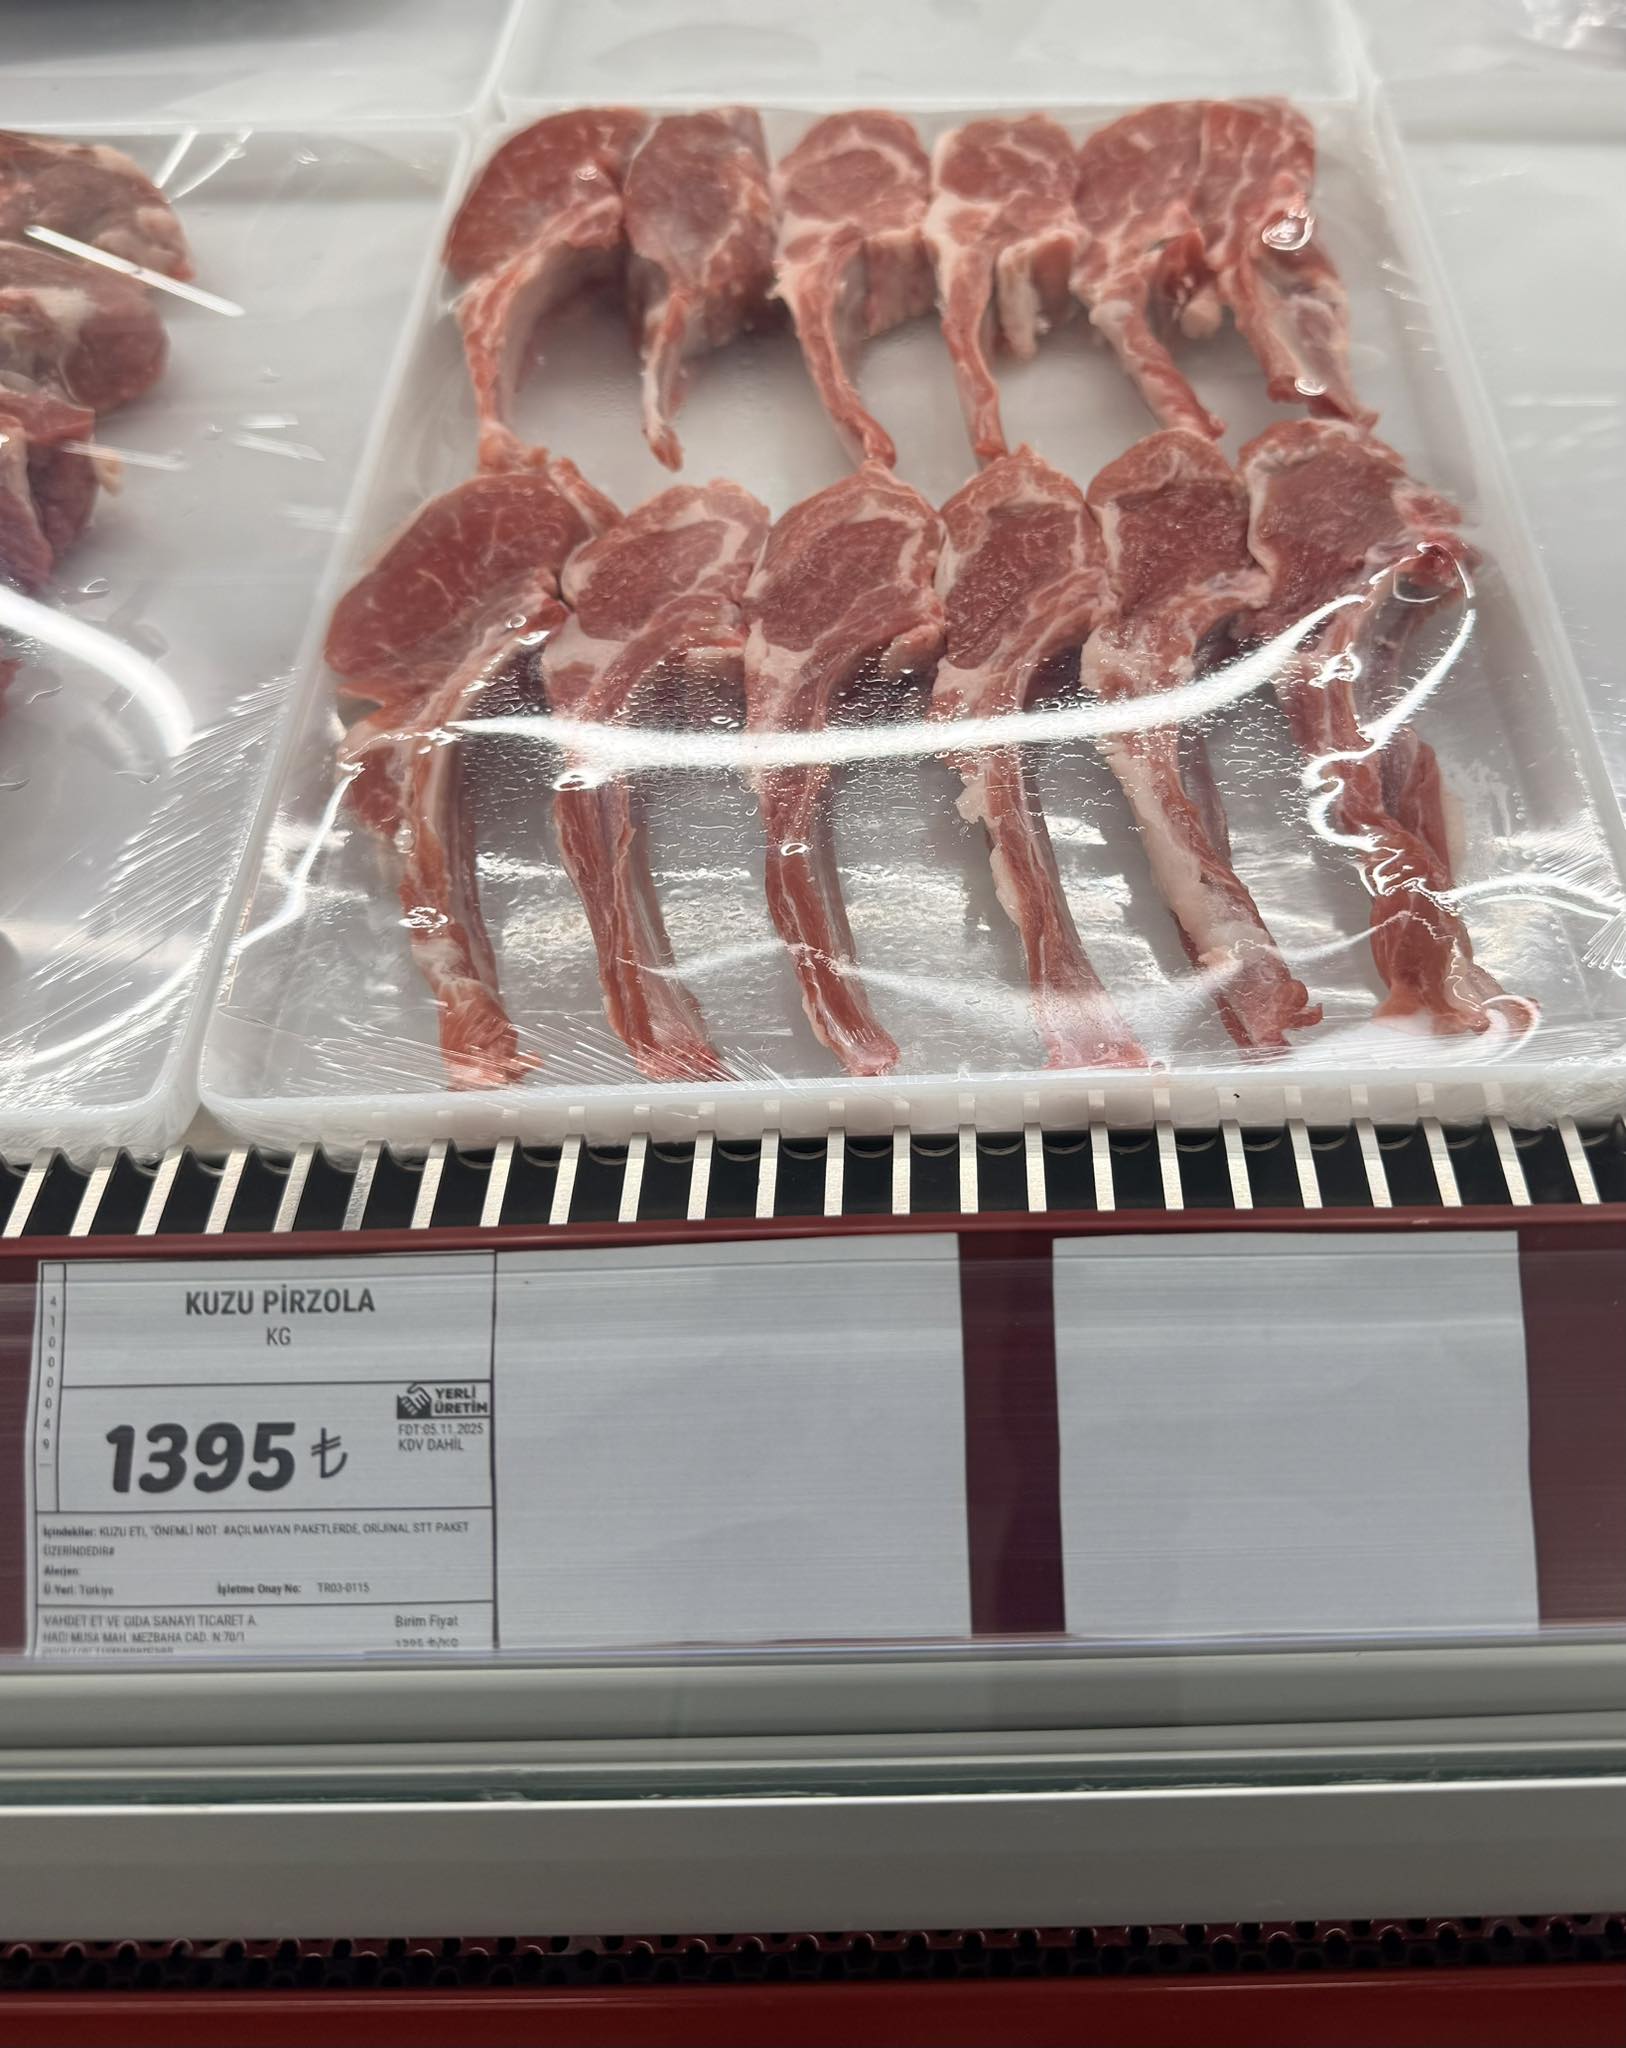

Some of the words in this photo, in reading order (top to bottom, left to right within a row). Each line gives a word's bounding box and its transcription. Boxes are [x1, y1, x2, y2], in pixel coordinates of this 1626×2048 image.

[185, 1291, 254, 1315] KUZU
[262, 1284, 376, 1314] PİRZOLA
[266, 1327, 291, 1346] KG
[435, 1385, 476, 1399] YERLİ
[434, 1400, 488, 1414] ÜRETİM
[398, 1438, 423, 1451] KDV
[427, 1435, 464, 1451] DAHİL
[106, 1422, 296, 1493] 1395
[99, 1526, 126, 1537] KUZU
[413, 1522, 432, 1533] STT
[435, 1521, 469, 1533] PAKET
[257, 1583, 282, 1596] Onay
[284, 1583, 302, 1594] No:
[106, 1615, 121, 1627] VE
[395, 1615, 426, 1627] Birim
[429, 1614, 459, 1629] Fiyat
